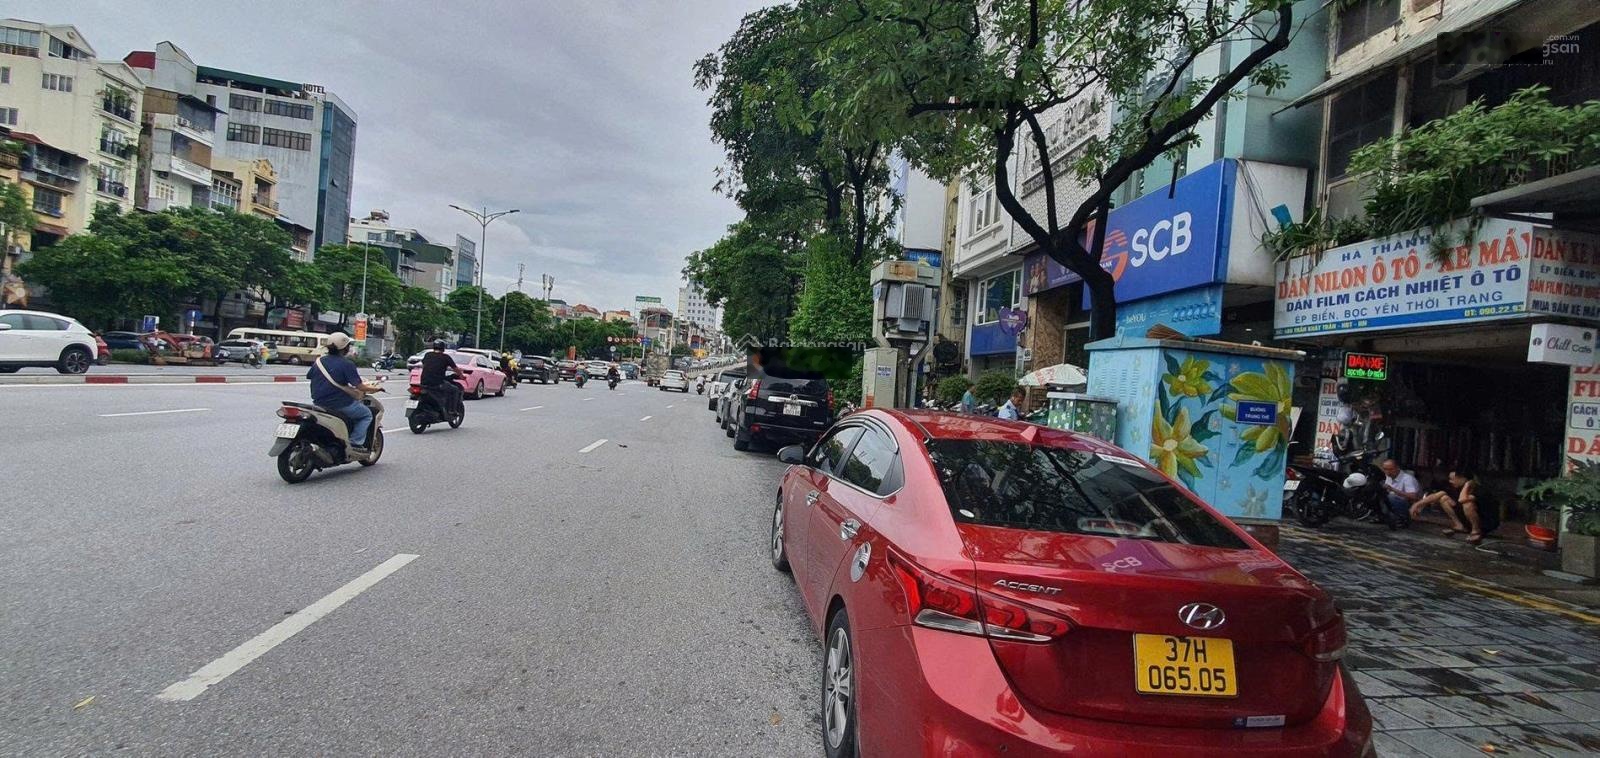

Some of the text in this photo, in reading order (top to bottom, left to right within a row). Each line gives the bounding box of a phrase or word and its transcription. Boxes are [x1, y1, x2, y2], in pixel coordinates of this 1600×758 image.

[303, 83, 326, 94] HOTEL
[1130, 211, 1192, 268] SCB
[1314, 265, 1368, 293] NILON
[1371, 256, 1387, 284] Ô
[1391, 248, 1420, 281] TÔ
[1286, 264, 1521, 312] DÁN FILM CÁCH NHIỆT Ô TÔ
[1545, 280, 1563, 295] FILM
[1344, 307, 1368, 319] BỌC
[1374, 302, 1399, 315] YÊN
[1406, 297, 1439, 311] THỜI
[1447, 291, 1503, 306] TRANG
[1532, 299, 1549, 312] MUA
[1571, 304, 1581, 316] XE
[1322, 383, 1337, 394] FIL
[1573, 403, 1598, 415] CÁCH
[1586, 417, 1594, 427] Ô
[993, 579, 1062, 595] ACCENT
[1165, 637, 1207, 663] 37H
[1148, 665, 1226, 692] 065.05
